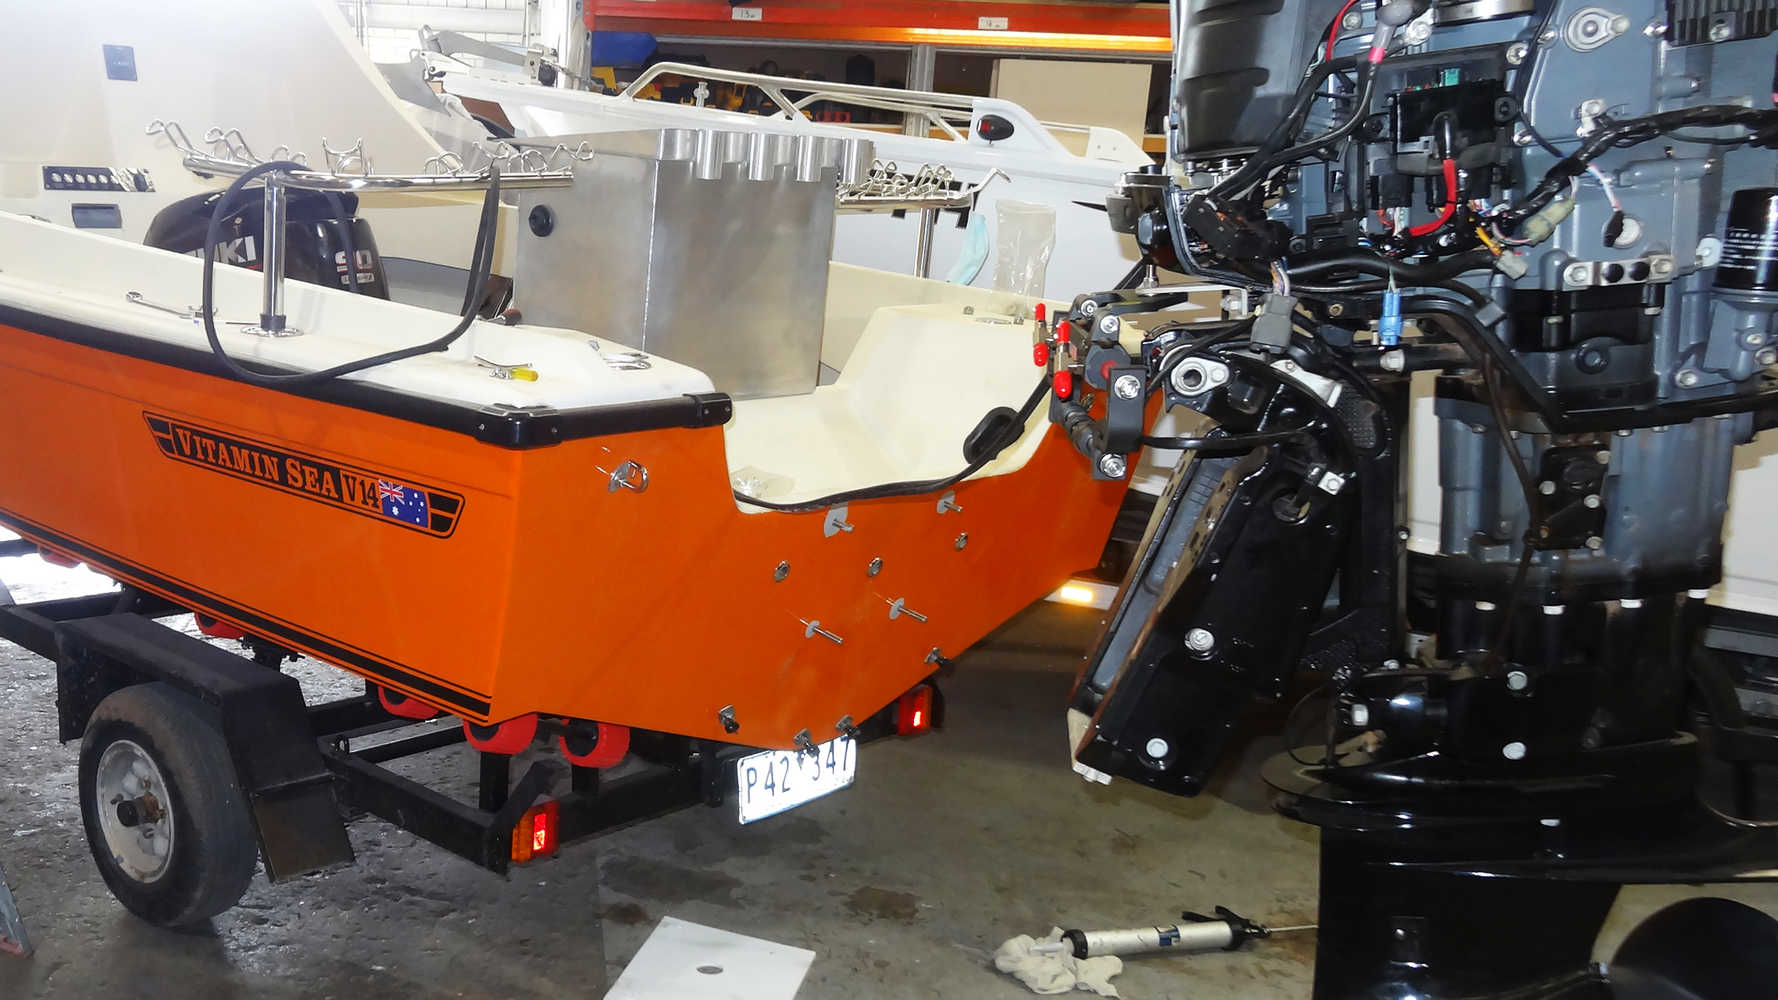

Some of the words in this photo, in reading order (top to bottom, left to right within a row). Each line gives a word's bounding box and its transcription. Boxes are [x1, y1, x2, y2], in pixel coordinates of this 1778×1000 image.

[175, 427, 281, 481] VITAMIN
[286, 458, 339, 499] SEA
[342, 474, 380, 509] V14
[746, 755, 791, 804] P42
[811, 736, 850, 782] 347
